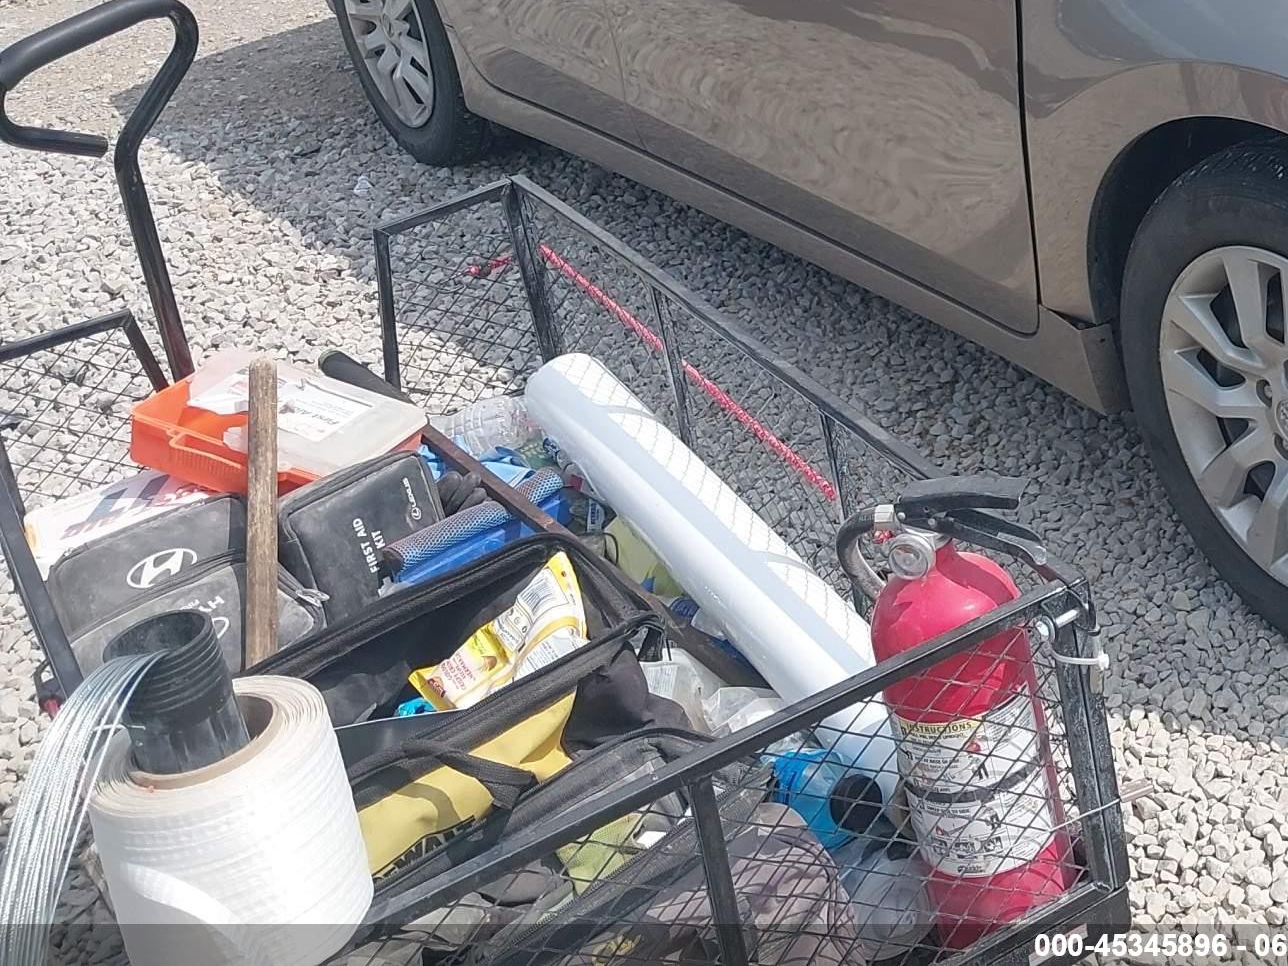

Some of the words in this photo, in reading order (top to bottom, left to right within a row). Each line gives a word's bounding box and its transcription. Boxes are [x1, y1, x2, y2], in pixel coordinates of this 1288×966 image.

[402, 477, 417, 508] LEXUS
[352, 517, 368, 538] AID
[371, 530, 386, 549] KIT
[360, 542, 379, 574] FIRST
